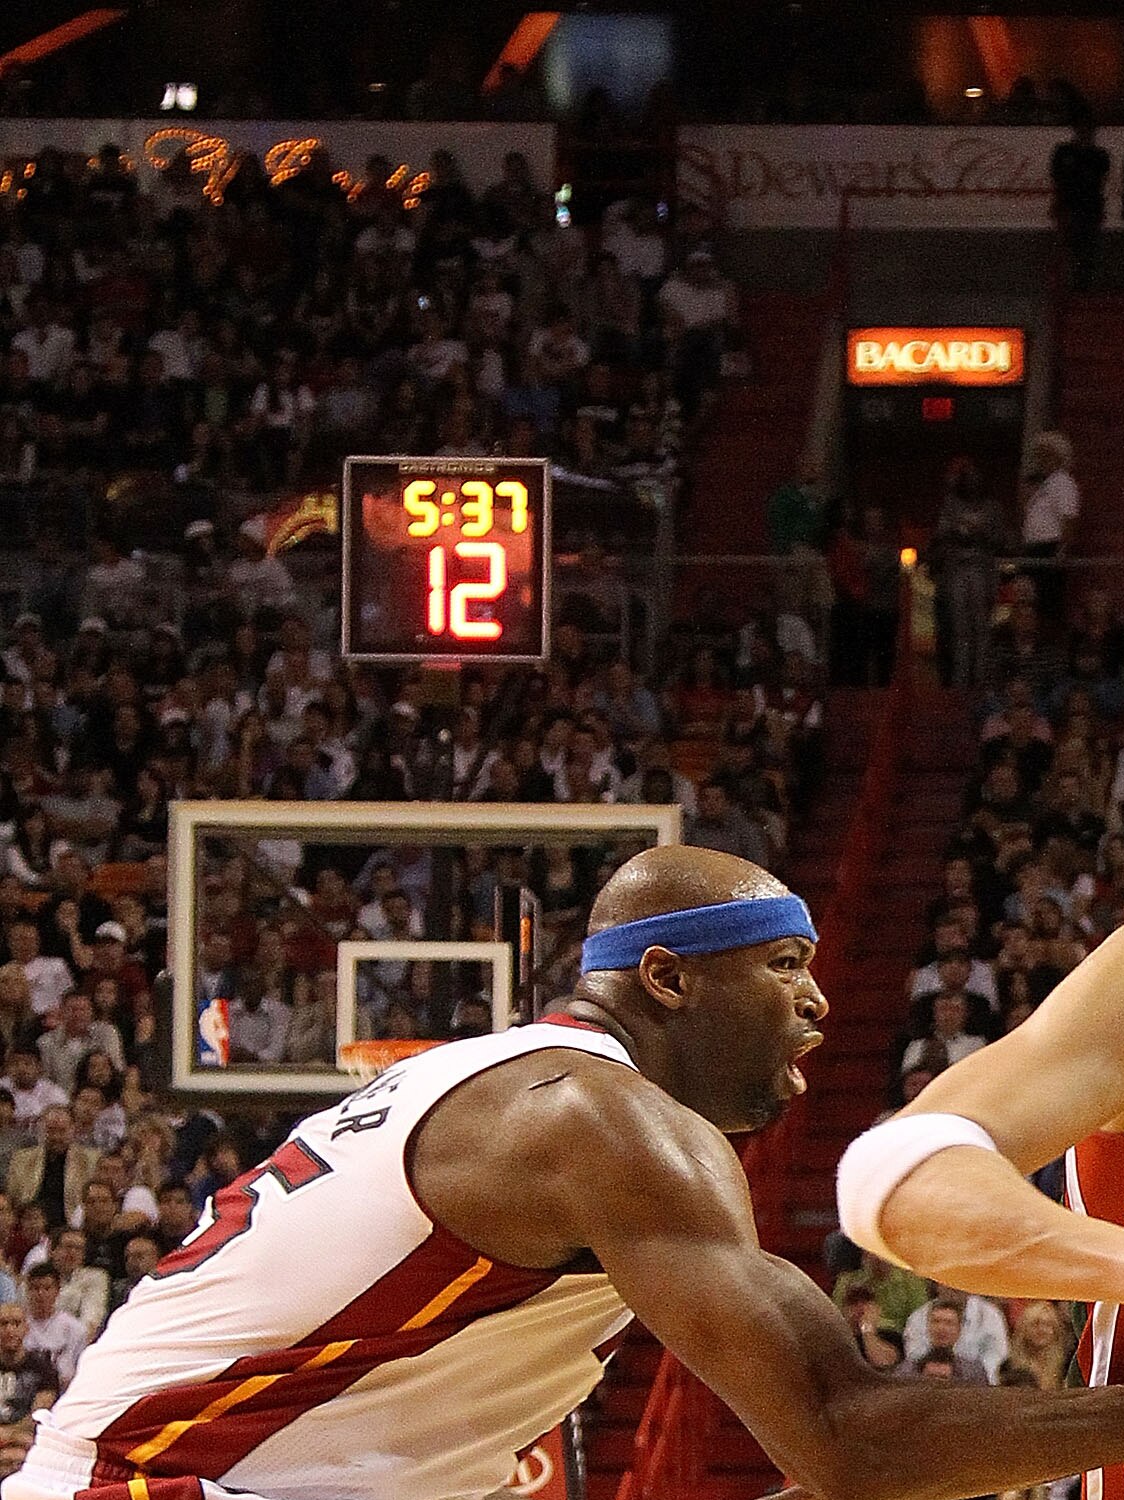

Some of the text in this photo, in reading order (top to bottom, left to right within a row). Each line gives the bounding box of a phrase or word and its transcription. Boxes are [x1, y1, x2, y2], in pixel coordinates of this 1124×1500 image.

[855, 340, 1012, 373] BACARDI
[403, 480, 529, 537] 5:37
[428, 542, 508, 641] 12
